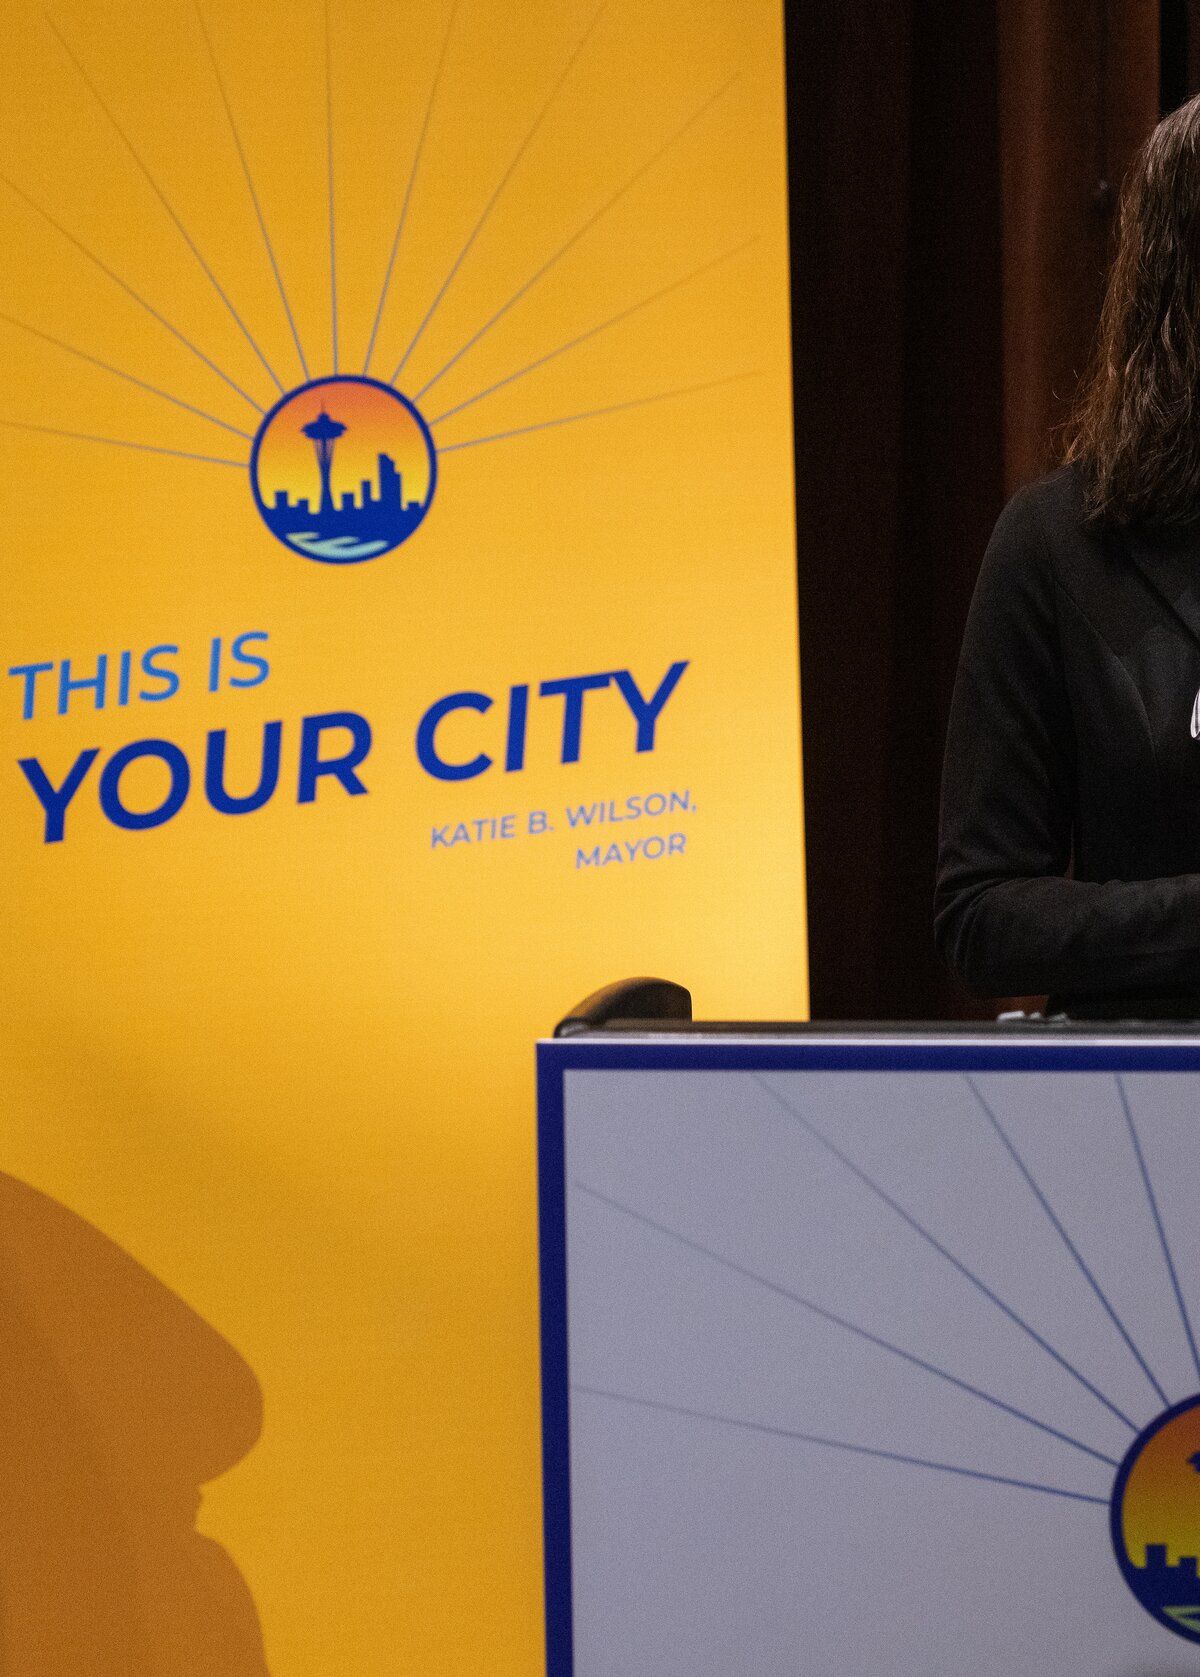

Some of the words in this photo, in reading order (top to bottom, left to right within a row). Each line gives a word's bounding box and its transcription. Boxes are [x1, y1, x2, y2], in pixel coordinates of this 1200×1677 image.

[7, 643, 181, 721] THIS
[207, 629, 272, 694] IS
[17, 710, 374, 845] YOUR
[414, 659, 692, 783] CITY
[429, 814, 518, 849] KATIE
[527, 809, 556, 835] B.
[565, 789, 699, 829] WILSON,
[574, 831, 689, 870] MAYOR
